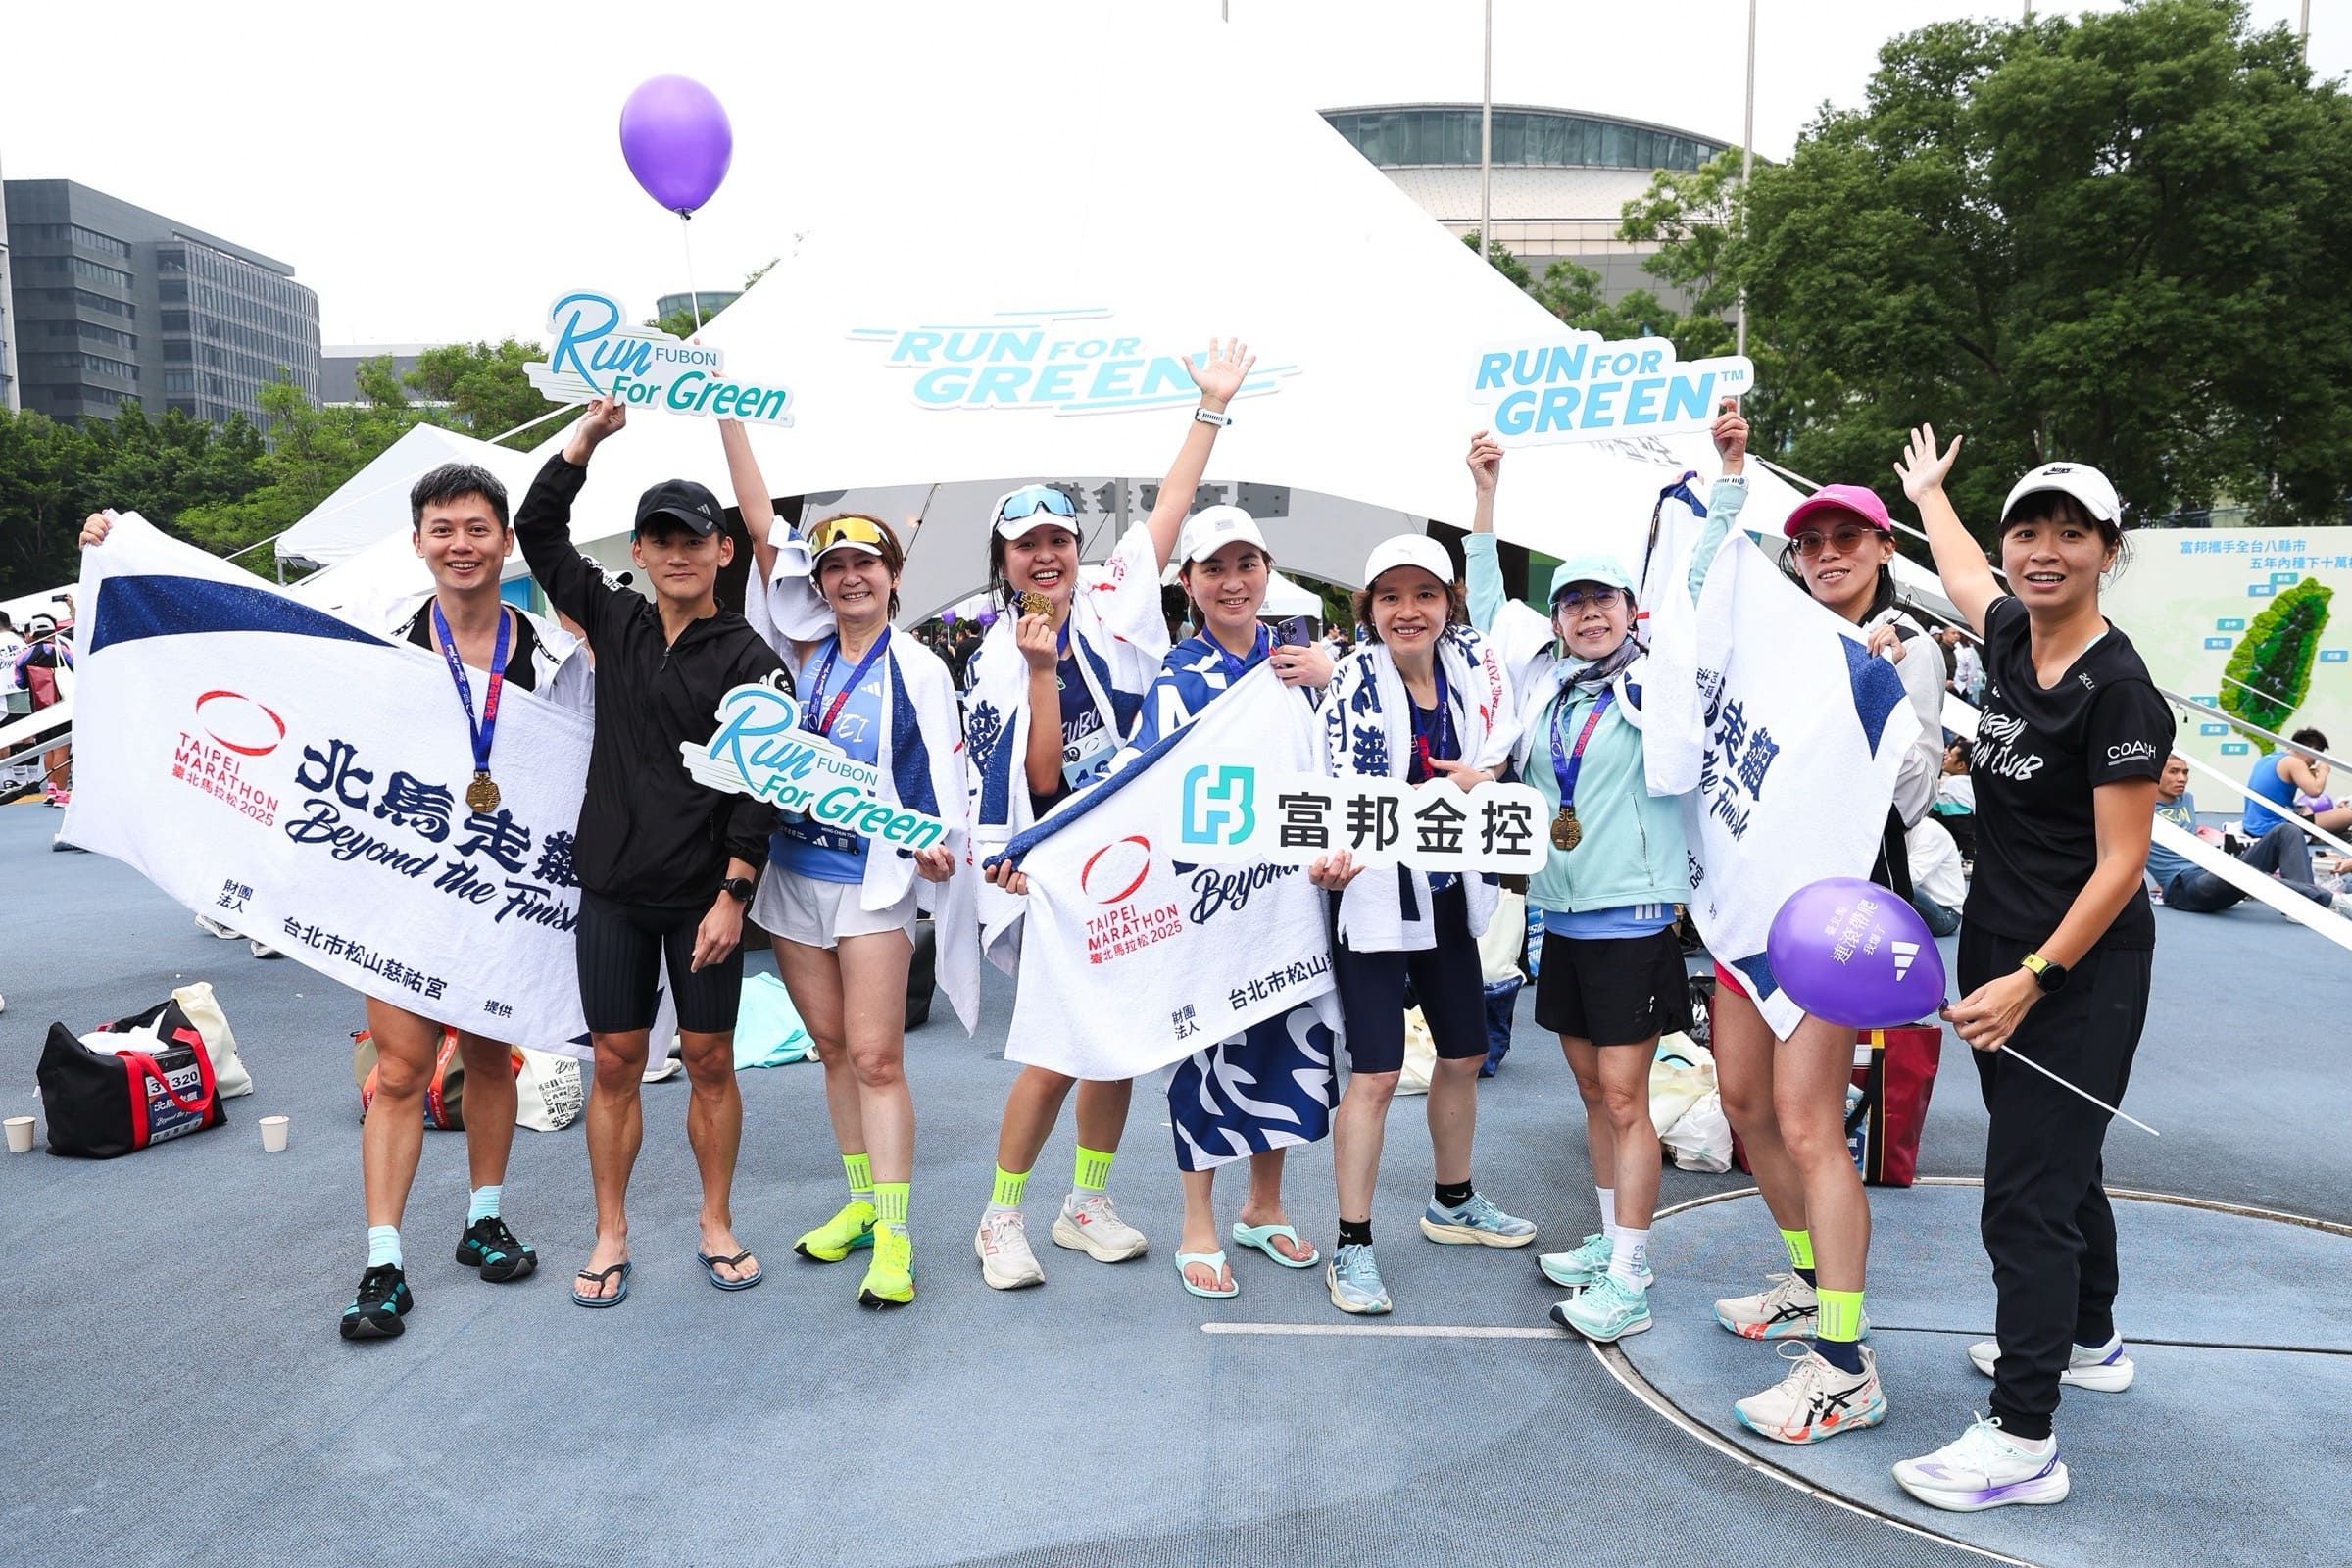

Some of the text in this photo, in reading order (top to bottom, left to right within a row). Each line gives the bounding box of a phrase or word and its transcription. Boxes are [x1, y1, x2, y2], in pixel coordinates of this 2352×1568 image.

[553, 294, 716, 396] Run FUBON
[890, 331, 1142, 363] RUN FOR
[1476, 344, 1662, 390] RUN FOR
[612, 375, 662, 405] For
[667, 370, 785, 419] Green
[911, 350, 1212, 404] GREEN
[1495, 372, 1716, 435] GREEN
[179, 731, 240, 774] TAIPEI
[710, 690, 816, 792] Run
[816, 757, 878, 786] FUBON
[1991, 745, 2043, 781] CLUB
[172, 763, 275, 827] 臺北馬拉松 2025
[175, 747, 278, 812] MARATHON
[760, 774, 943, 850] For Green
[1278, 791, 1533, 856] 富邦金控
[285, 799, 439, 879] Beyond
[433, 860, 498, 905] the
[216, 893, 245, 914] 法人
[223, 878, 254, 901] 財團
[1086, 904, 1136, 935] TAIPEI
[1087, 904, 1179, 951] MARATHON
[1089, 921, 1183, 964] 臺北馬拉松 2025
[283, 916, 448, 1001] 台北市松山慈祐宮
[483, 999, 514, 1019] 提供
[1172, 1004, 1196, 1025] 財團
[1174, 1020, 1200, 1041] 法人
[150, 1071, 198, 1093] 3320
